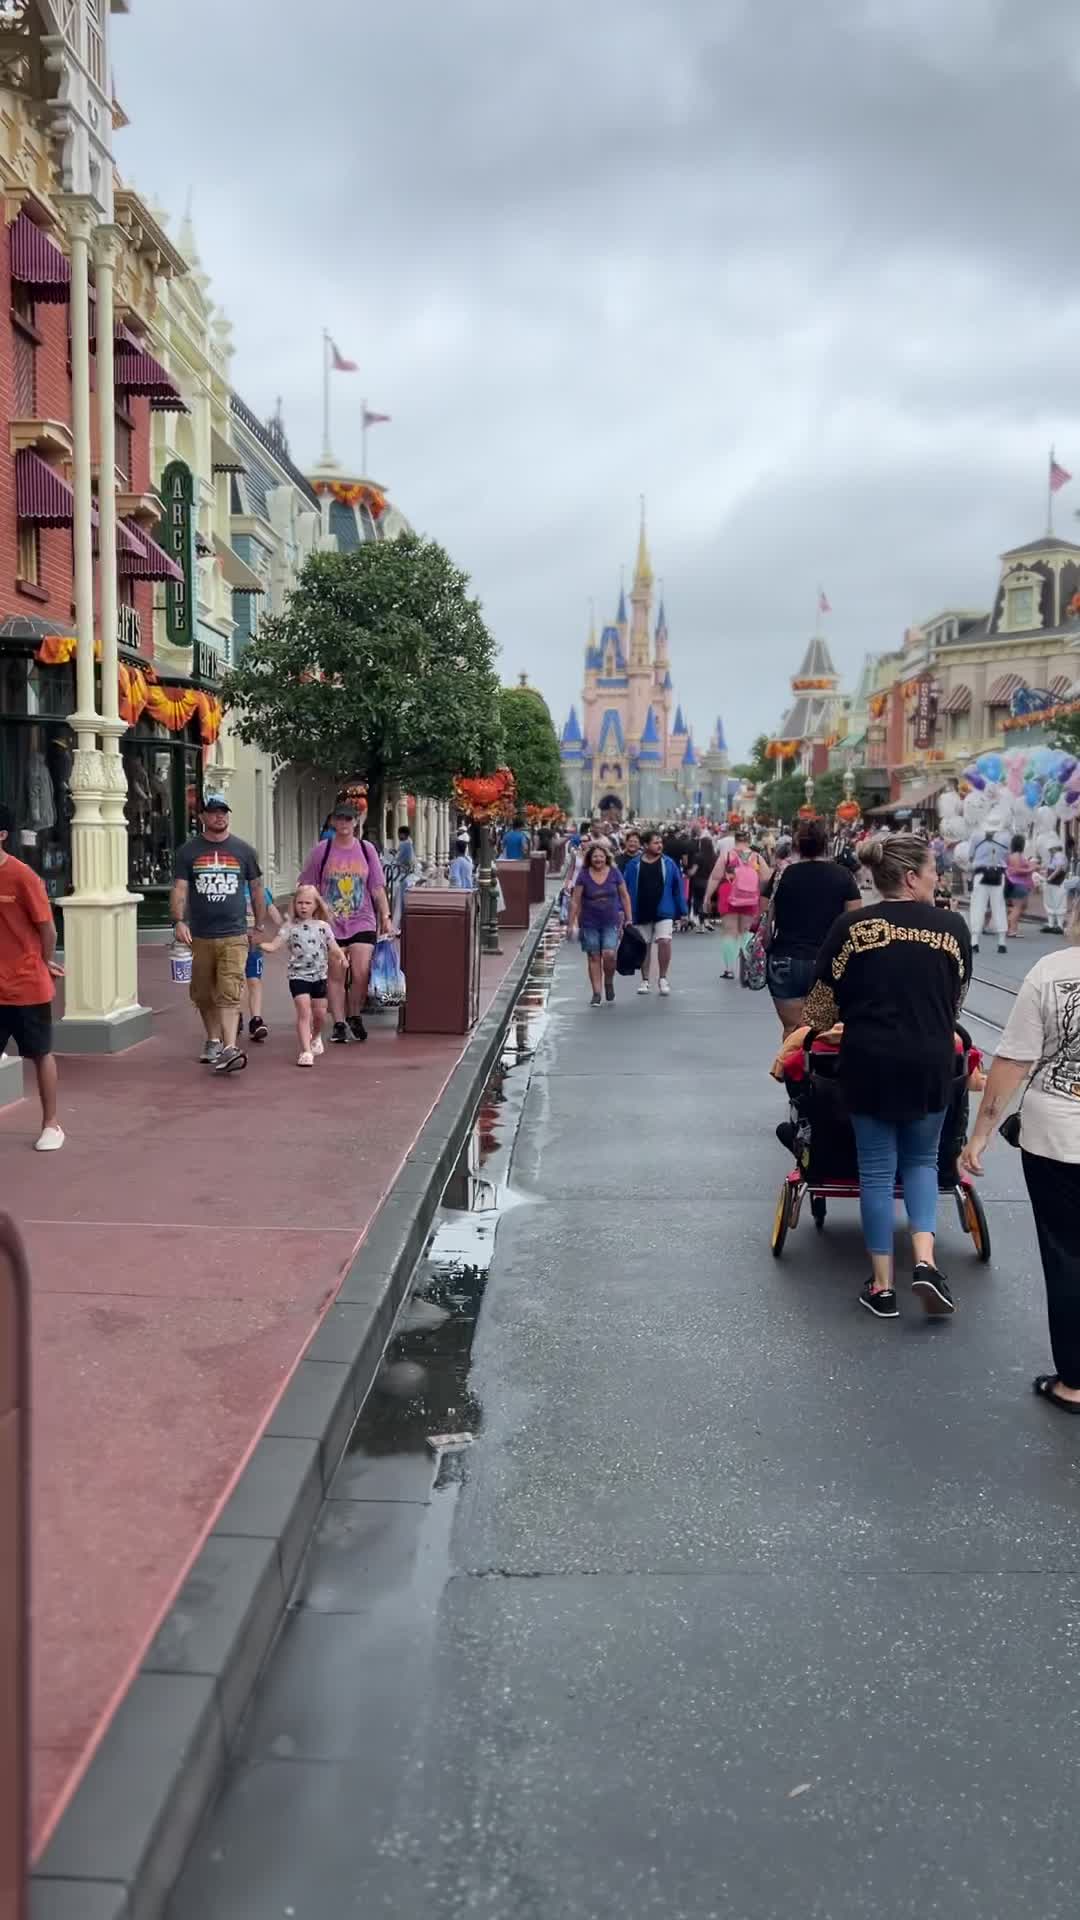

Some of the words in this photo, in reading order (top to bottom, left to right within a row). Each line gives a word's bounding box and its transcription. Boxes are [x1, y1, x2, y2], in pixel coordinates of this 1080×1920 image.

[196, 873, 238, 884] STAR
[195, 882, 238, 894] WARS
[207, 894, 226, 902] 1977
